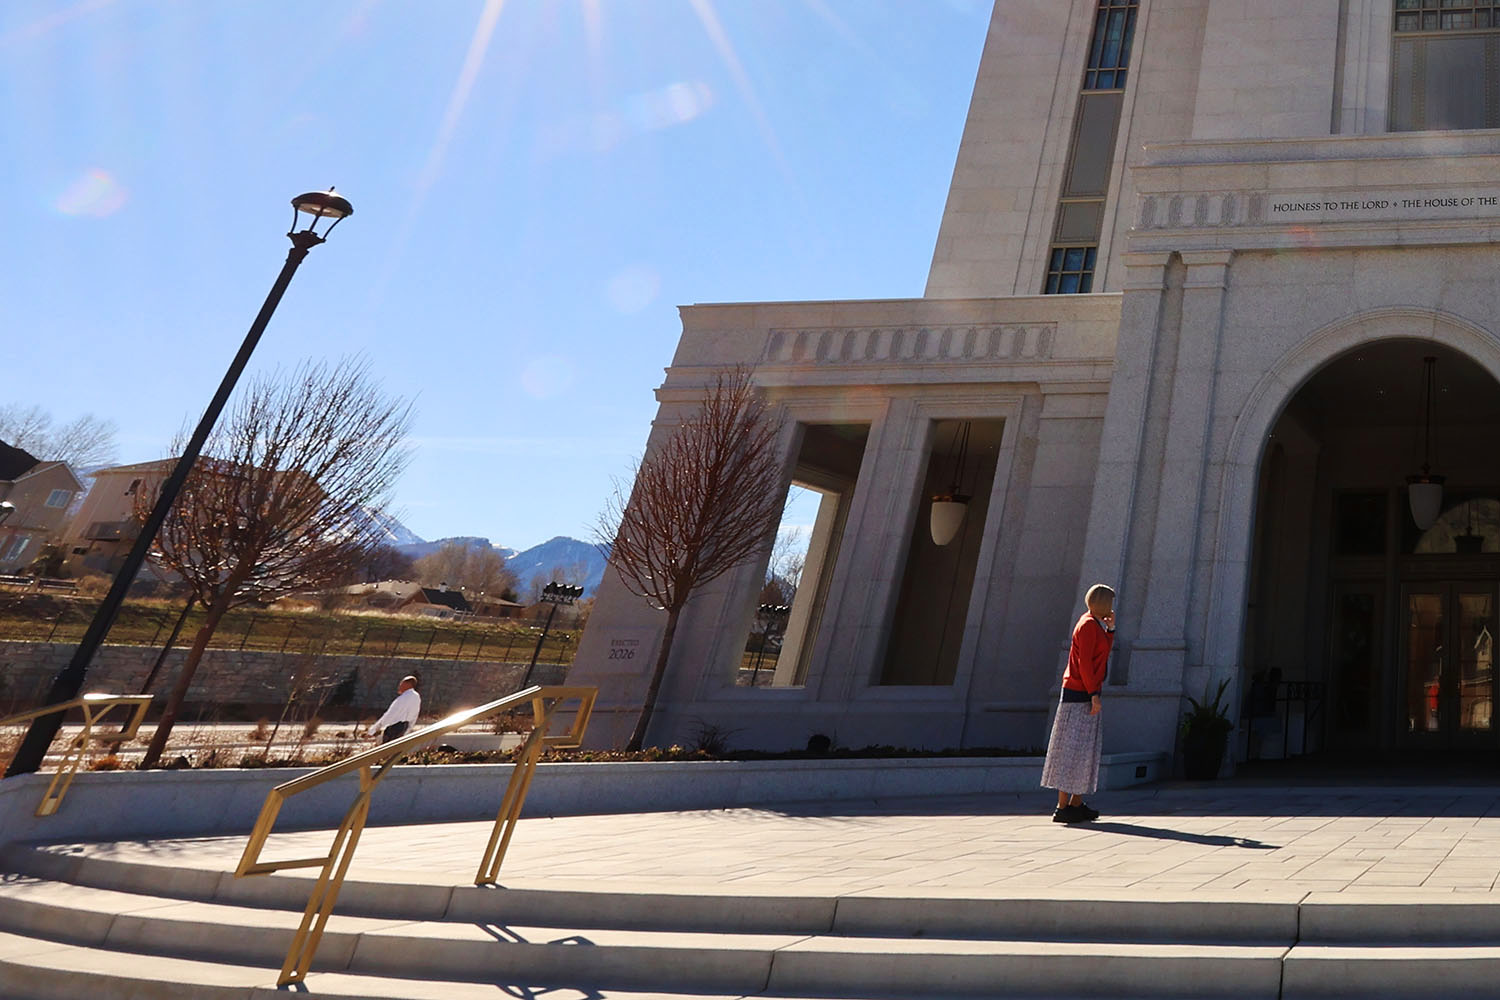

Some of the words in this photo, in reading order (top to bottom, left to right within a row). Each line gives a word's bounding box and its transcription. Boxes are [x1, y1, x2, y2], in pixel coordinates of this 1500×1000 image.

[1273, 202, 1321, 212] HOLINESS
[1324, 202, 1338, 211] TO
[1340, 201, 1359, 210] THE
[1362, 200, 1389, 209] LORD
[1402, 199, 1421, 208] THE
[1424, 198, 1458, 207] HOUSE
[1461, 197, 1475, 206] OF
[1478, 196, 1497, 205] THE
[608, 648, 635, 659] 2026
